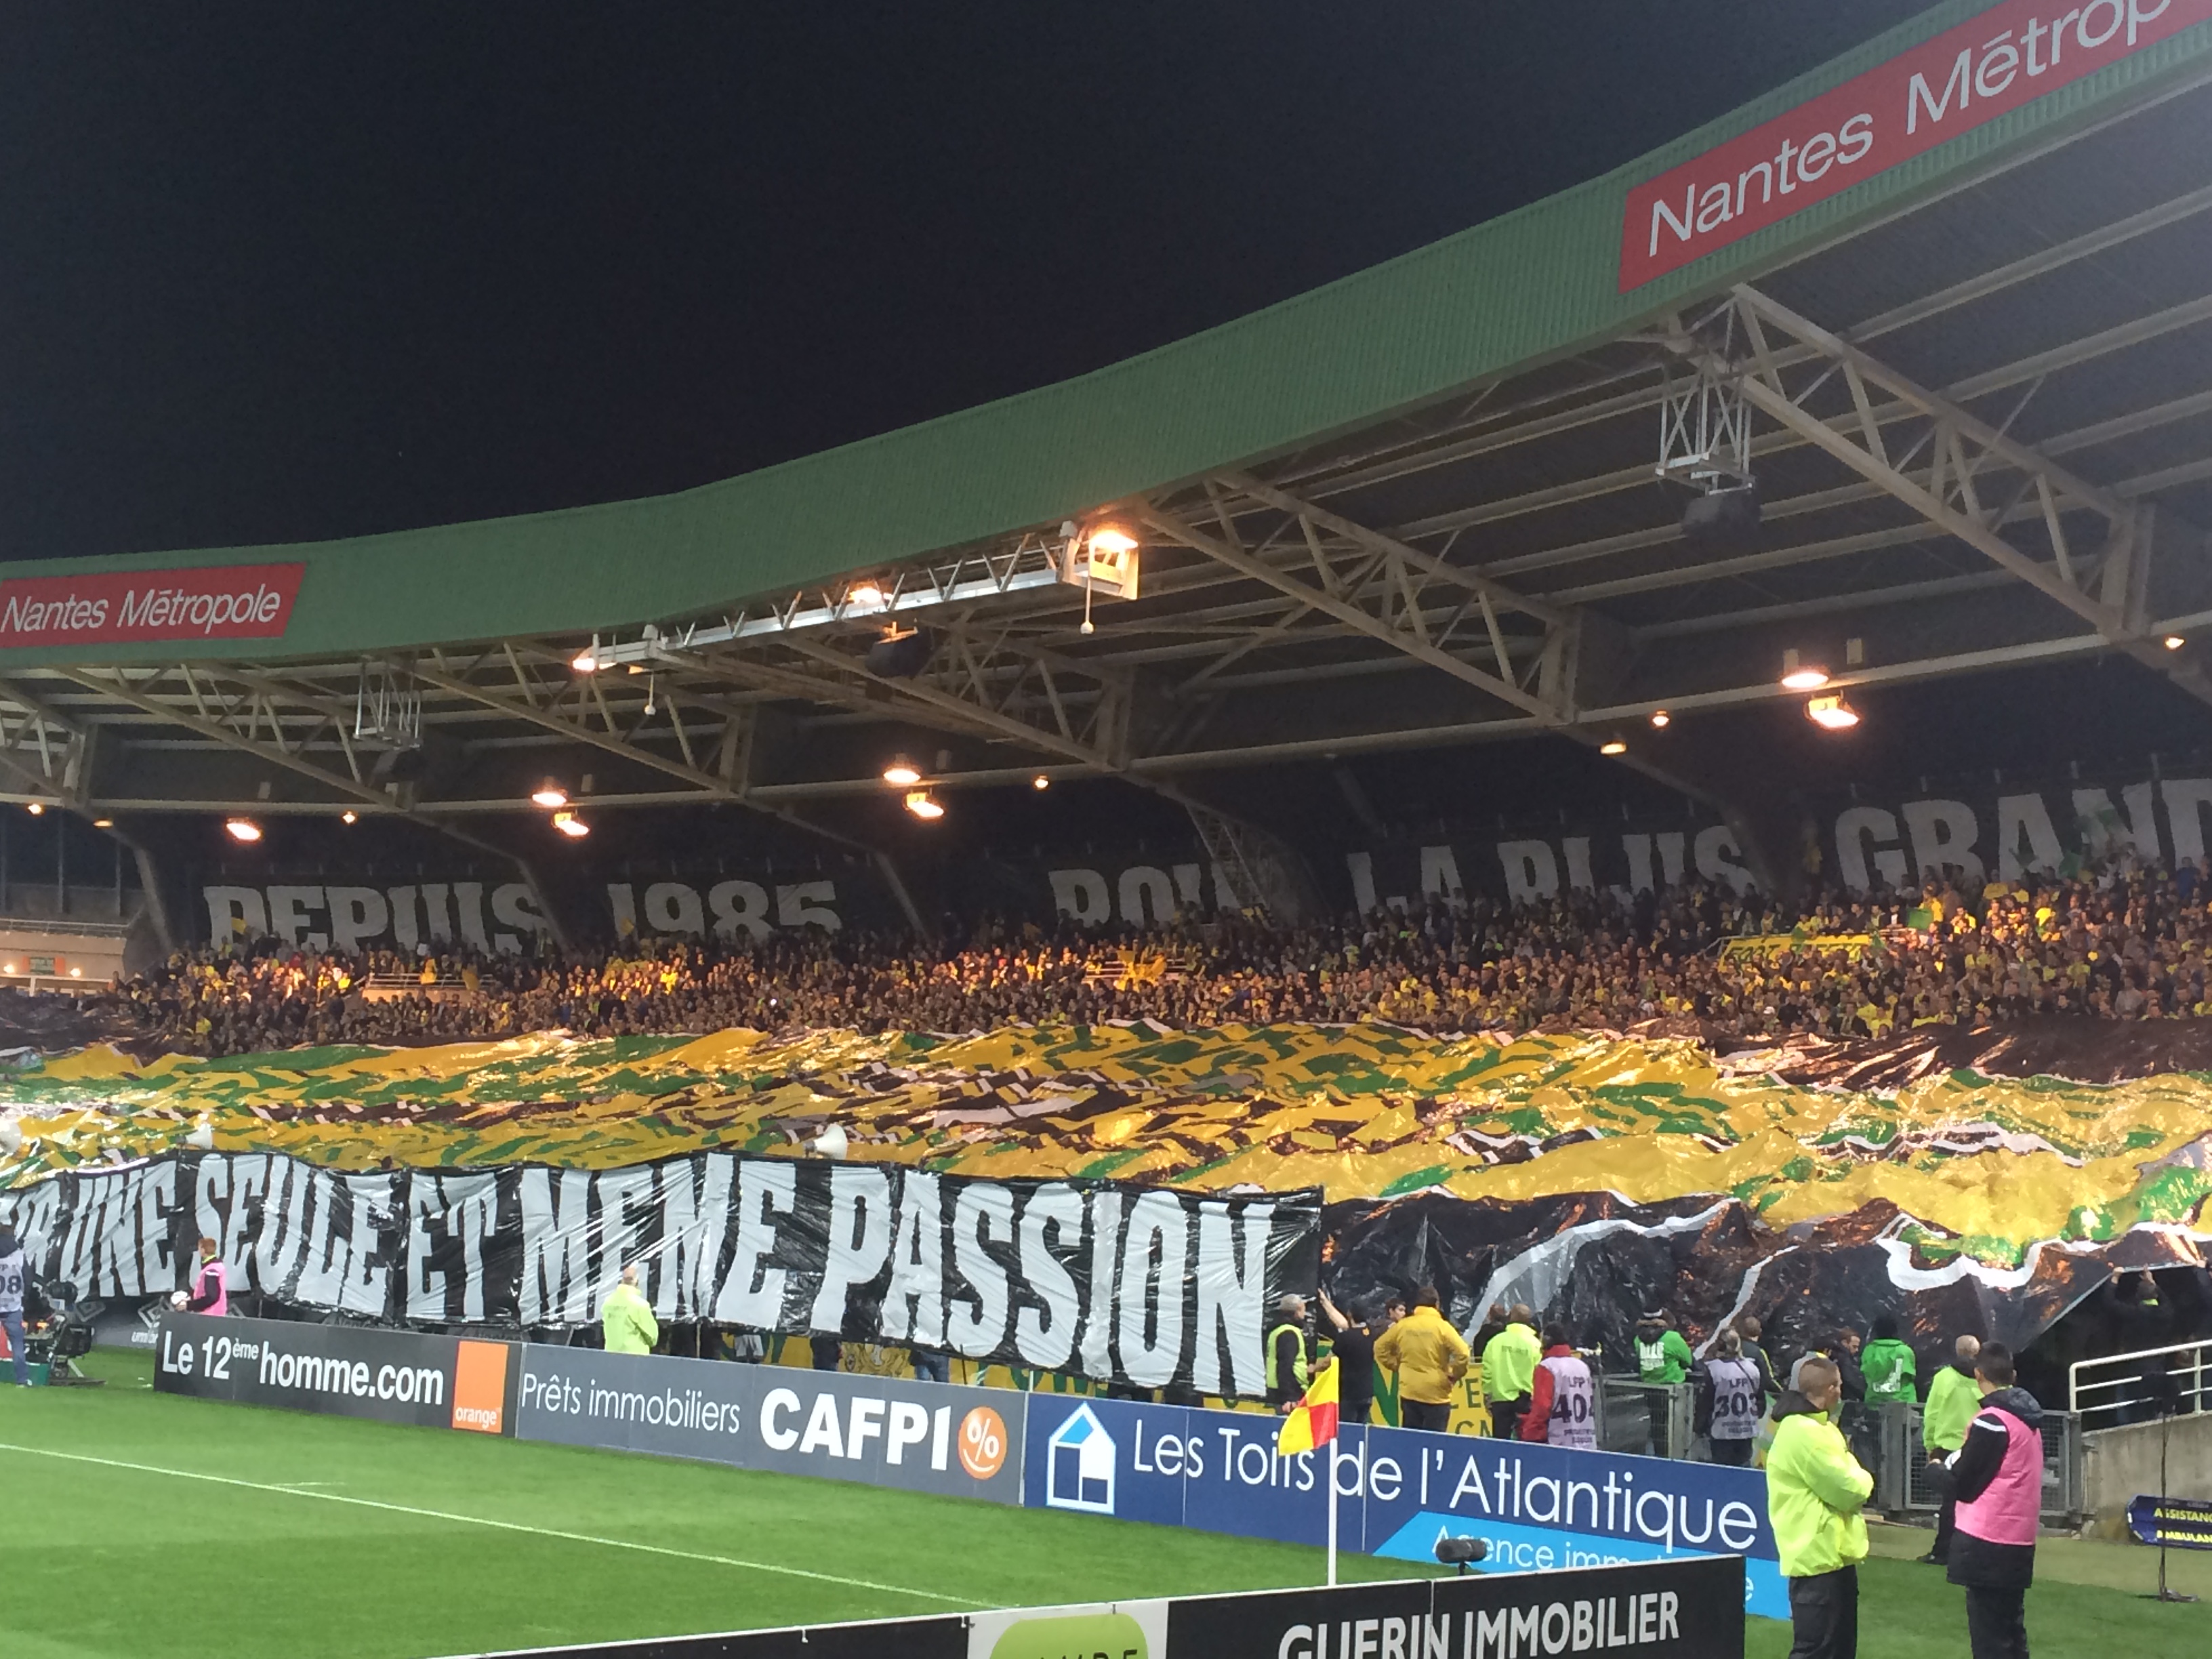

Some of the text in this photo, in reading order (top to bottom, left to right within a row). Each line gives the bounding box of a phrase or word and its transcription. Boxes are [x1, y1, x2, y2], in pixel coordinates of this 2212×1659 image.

[1647, 112, 1874, 257] Nantes
[0, 583, 281, 635] Nantes Métropole
[204, 882, 542, 954] DEPUIS
[607, 880, 842, 942] 1985
[189, 1154, 394, 1318] SEULE
[406, 1172, 498, 1320] ET
[810, 1165, 1275, 1396] PASSION
[162, 1331, 194, 1375] Le
[259, 1341, 443, 1405] homme.com
[521, 1372, 741, 1435] Prêts immobiliers
[455, 1407, 497, 1430] orange
[1134, 1419, 1204, 1477] Les
[1335, 1440, 1403, 1501] de
[1431, 1524, 1554, 1570] Aence
[1278, 1591, 1679, 1659] GUERIN IMMOBILIER
